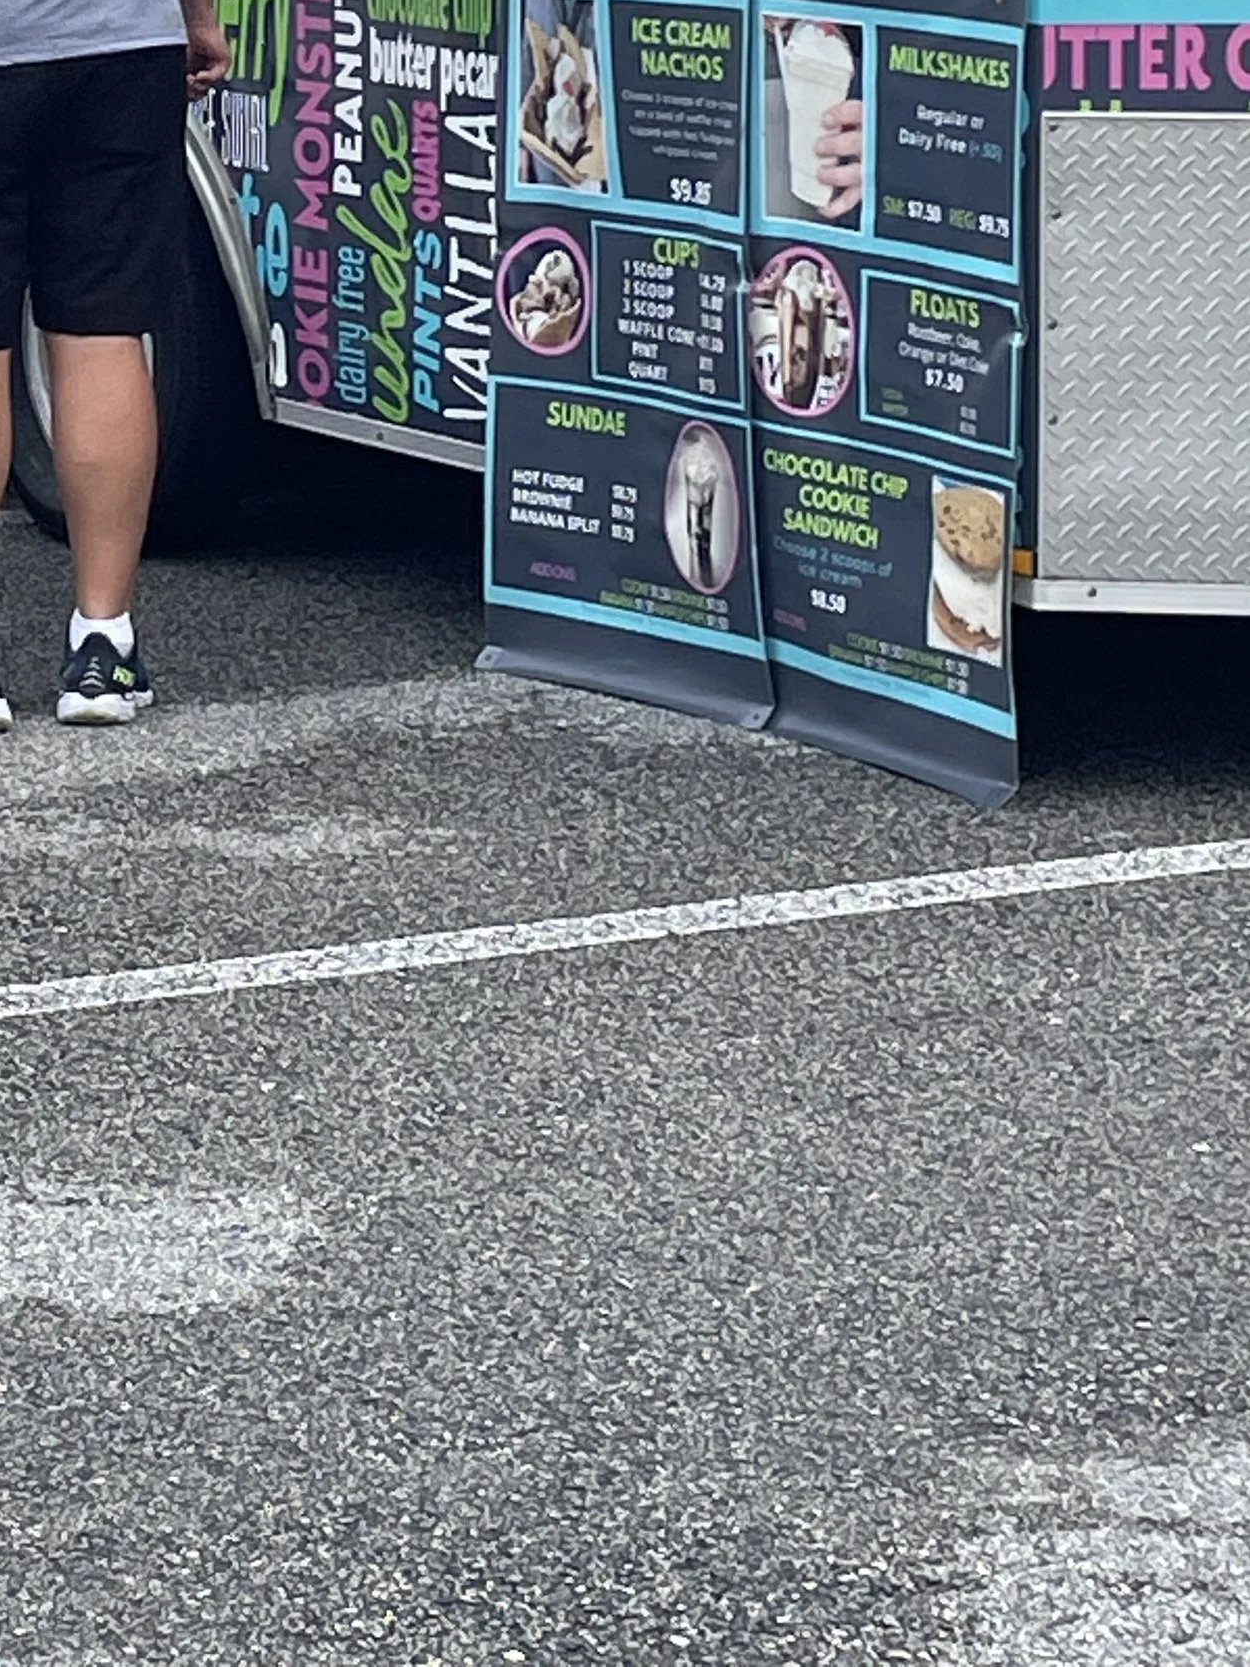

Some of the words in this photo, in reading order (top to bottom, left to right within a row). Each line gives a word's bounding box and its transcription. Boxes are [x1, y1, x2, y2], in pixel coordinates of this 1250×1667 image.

[631, 16, 662, 45] ICE
[664, 19, 733, 50] CREAM
[369, 25, 437, 92] butter
[639, 49, 726, 83] NACHOS
[888, 43, 1012, 90] MILKSHAKES
[916, 103, 969, 131] Regular
[970, 113, 985, 130] or
[899, 127, 933, 155] Dairy
[935, 132, 968, 155] Free
[412, 99, 443, 223] QUARTS
[443, 115, 499, 421] VANILLA
[632, 260, 675, 280] SCOOP
[653, 237, 700, 269] CUPS
[332, 244, 366, 313] free
[632, 280, 675, 300] SCOOP
[412, 229, 443, 413] PINTS
[632, 299, 675, 320] SCOOP
[910, 288, 980, 329] FLOATS
[334, 320, 370, 404] dairy
[545, 400, 627, 438] SUNDAE
[762, 447, 868, 493] CHOCOLATE
[870, 470, 909, 500] CHIP
[797, 484, 872, 521] COOKIE
[781, 507, 880, 553] SANDWICH
